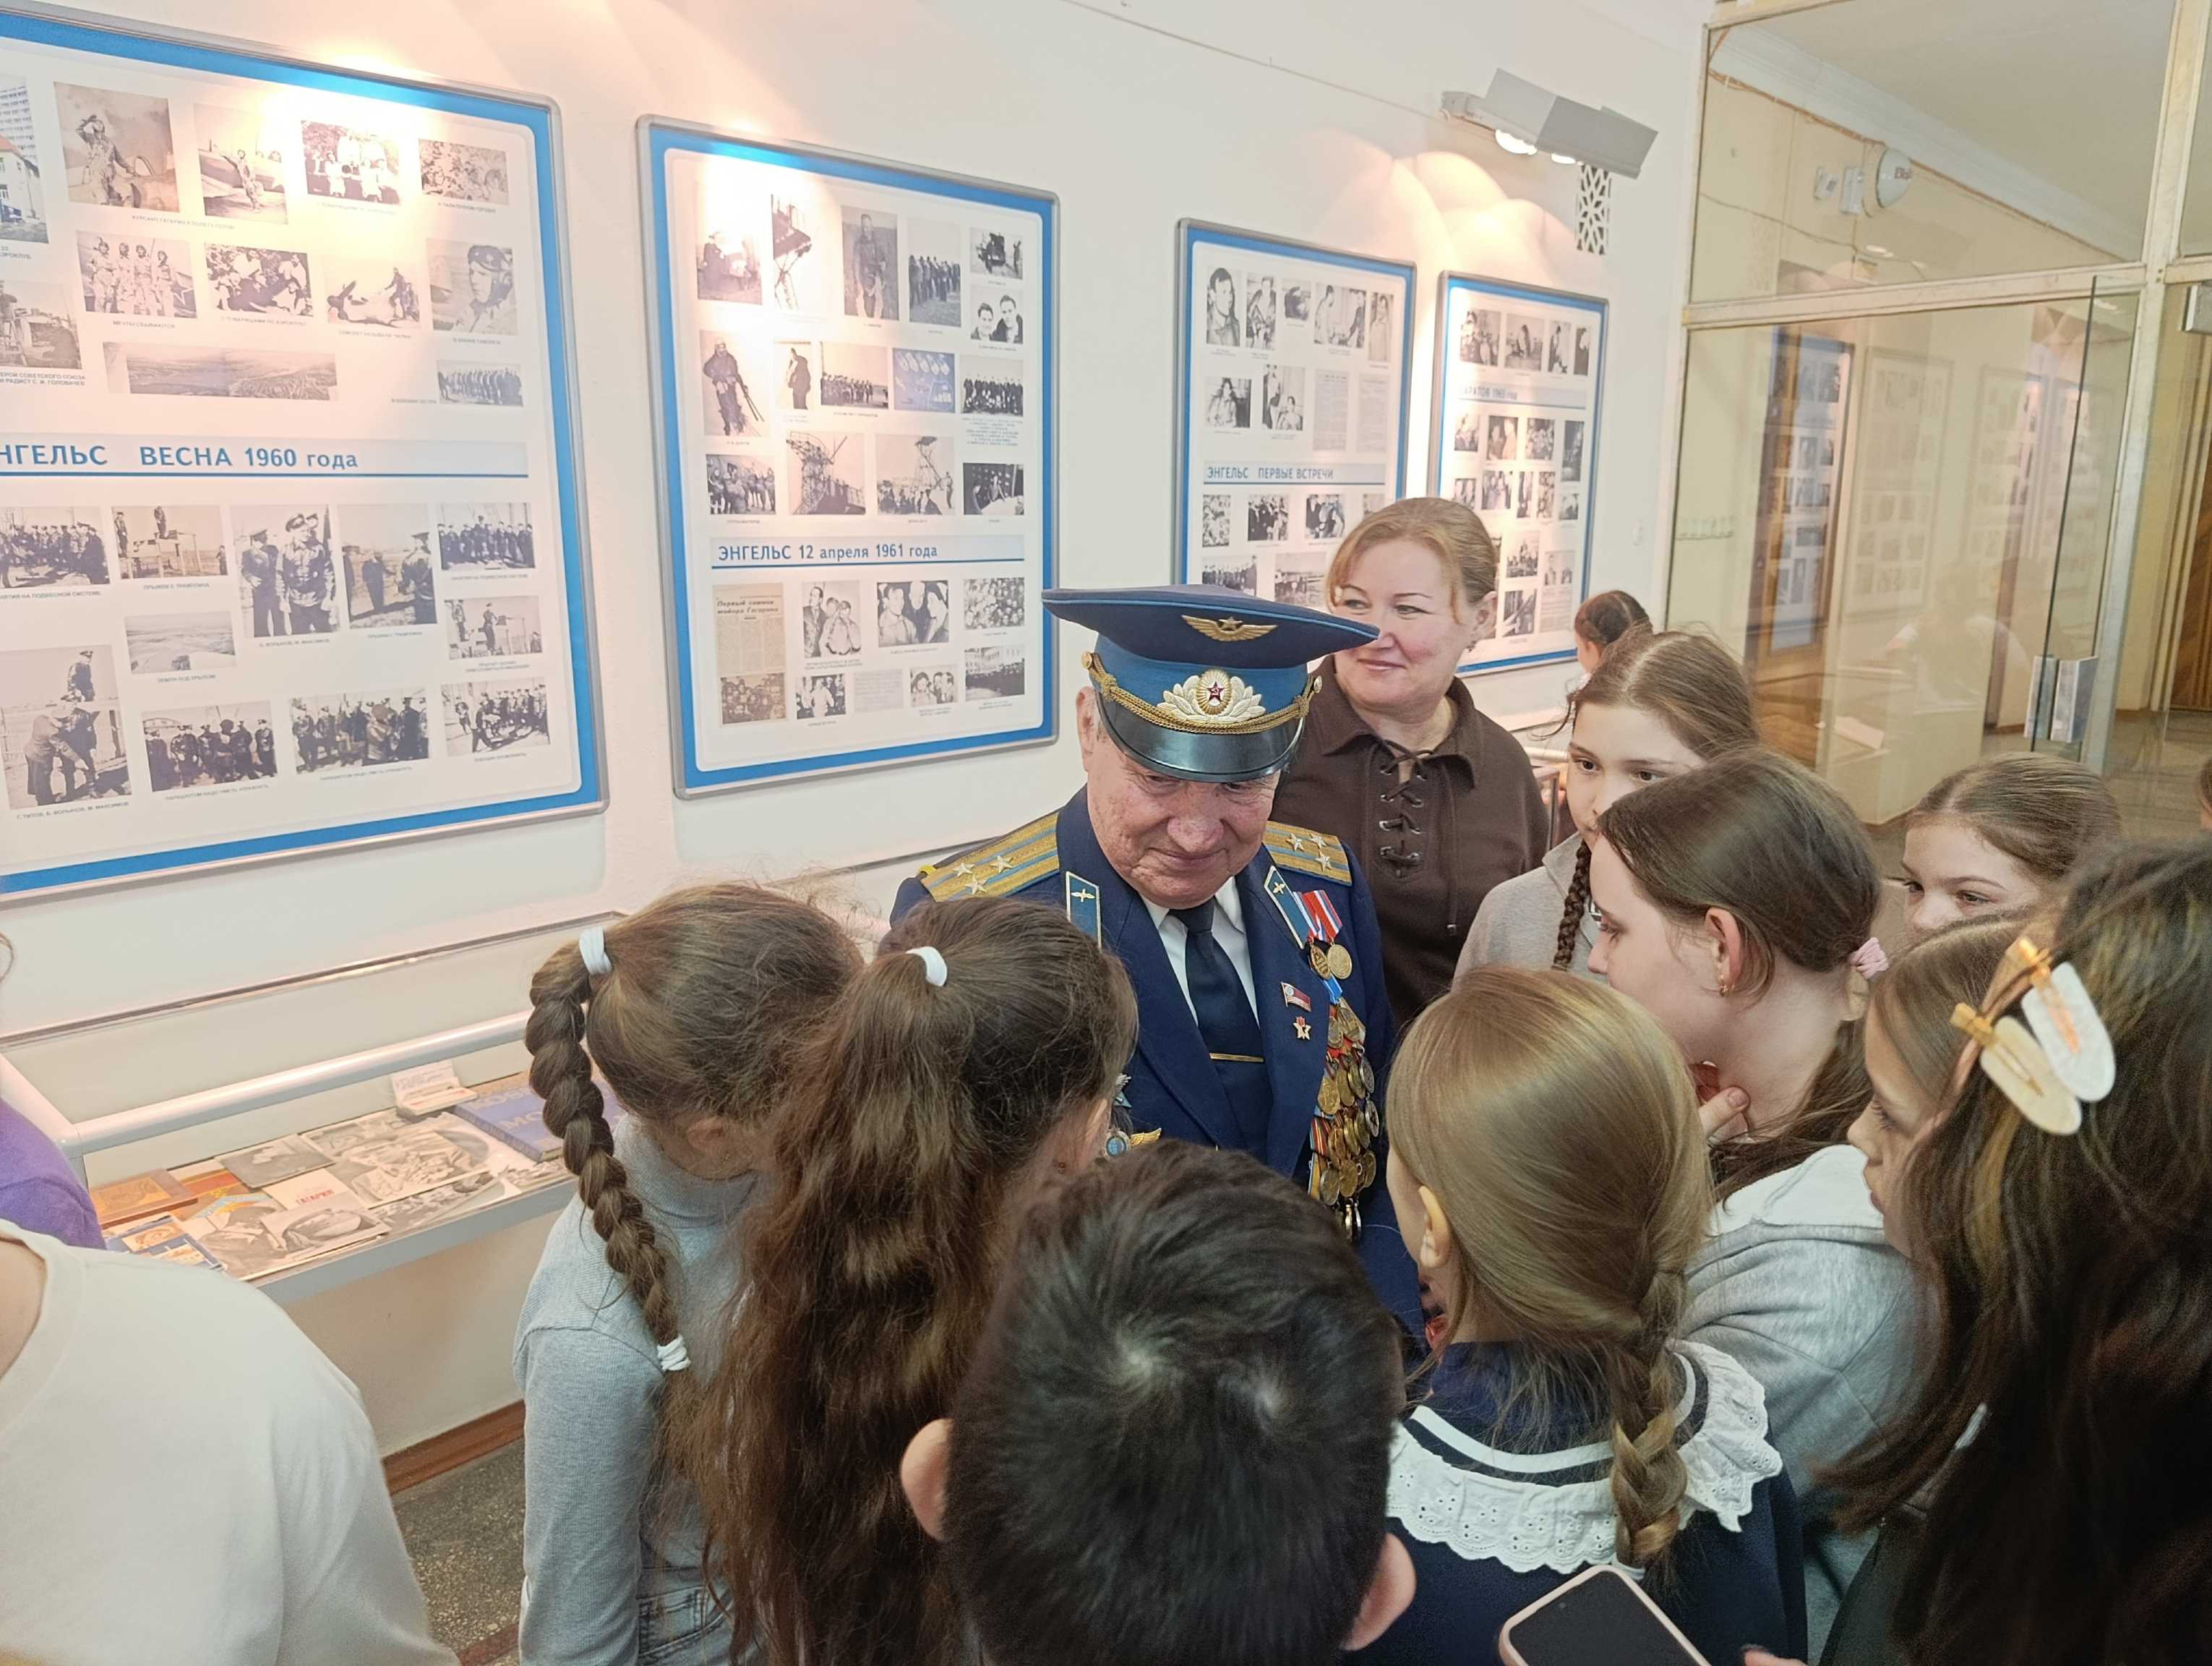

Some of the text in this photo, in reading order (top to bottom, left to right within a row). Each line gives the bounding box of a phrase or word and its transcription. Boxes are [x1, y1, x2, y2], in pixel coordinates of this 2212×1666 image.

[0, 445, 358, 469] НГЕЛЬС ВЕСНА 1960 года
[1207, 466, 1334, 479] ЭНГЕЛЬС ПЕРВЫЕ ВСТРЕЧИ
[718, 544, 938, 561] ЭНГЕЛЬС 12 апреля 1961 года
